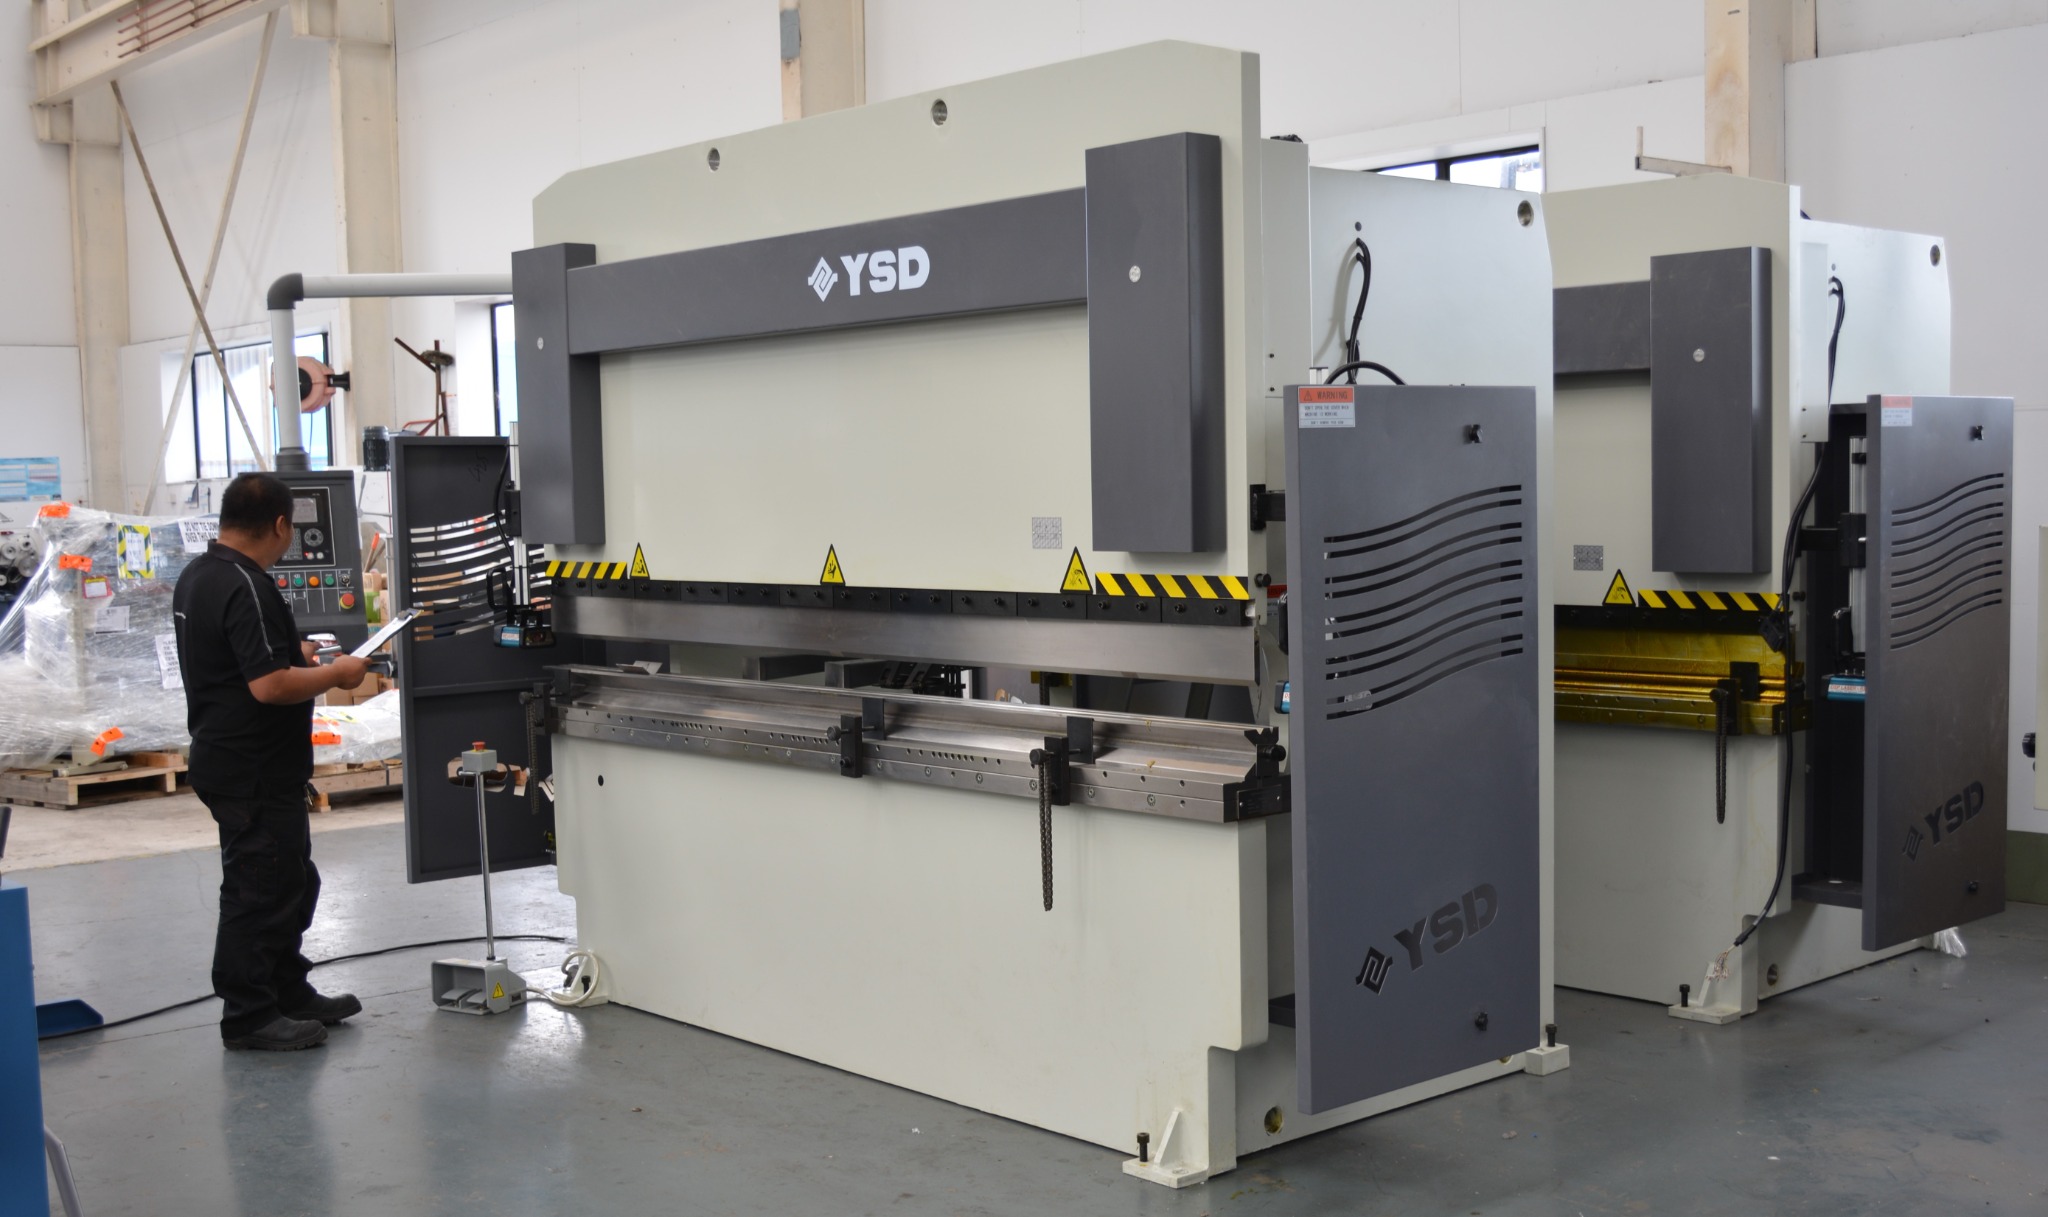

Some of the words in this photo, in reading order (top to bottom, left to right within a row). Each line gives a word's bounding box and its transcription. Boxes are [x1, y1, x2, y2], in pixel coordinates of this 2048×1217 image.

[840, 246, 930, 296] YSD
[1316, 391, 1349, 400] WARNING
[1923, 781, 1984, 846] YSD
[1393, 883, 1498, 972] YSD
